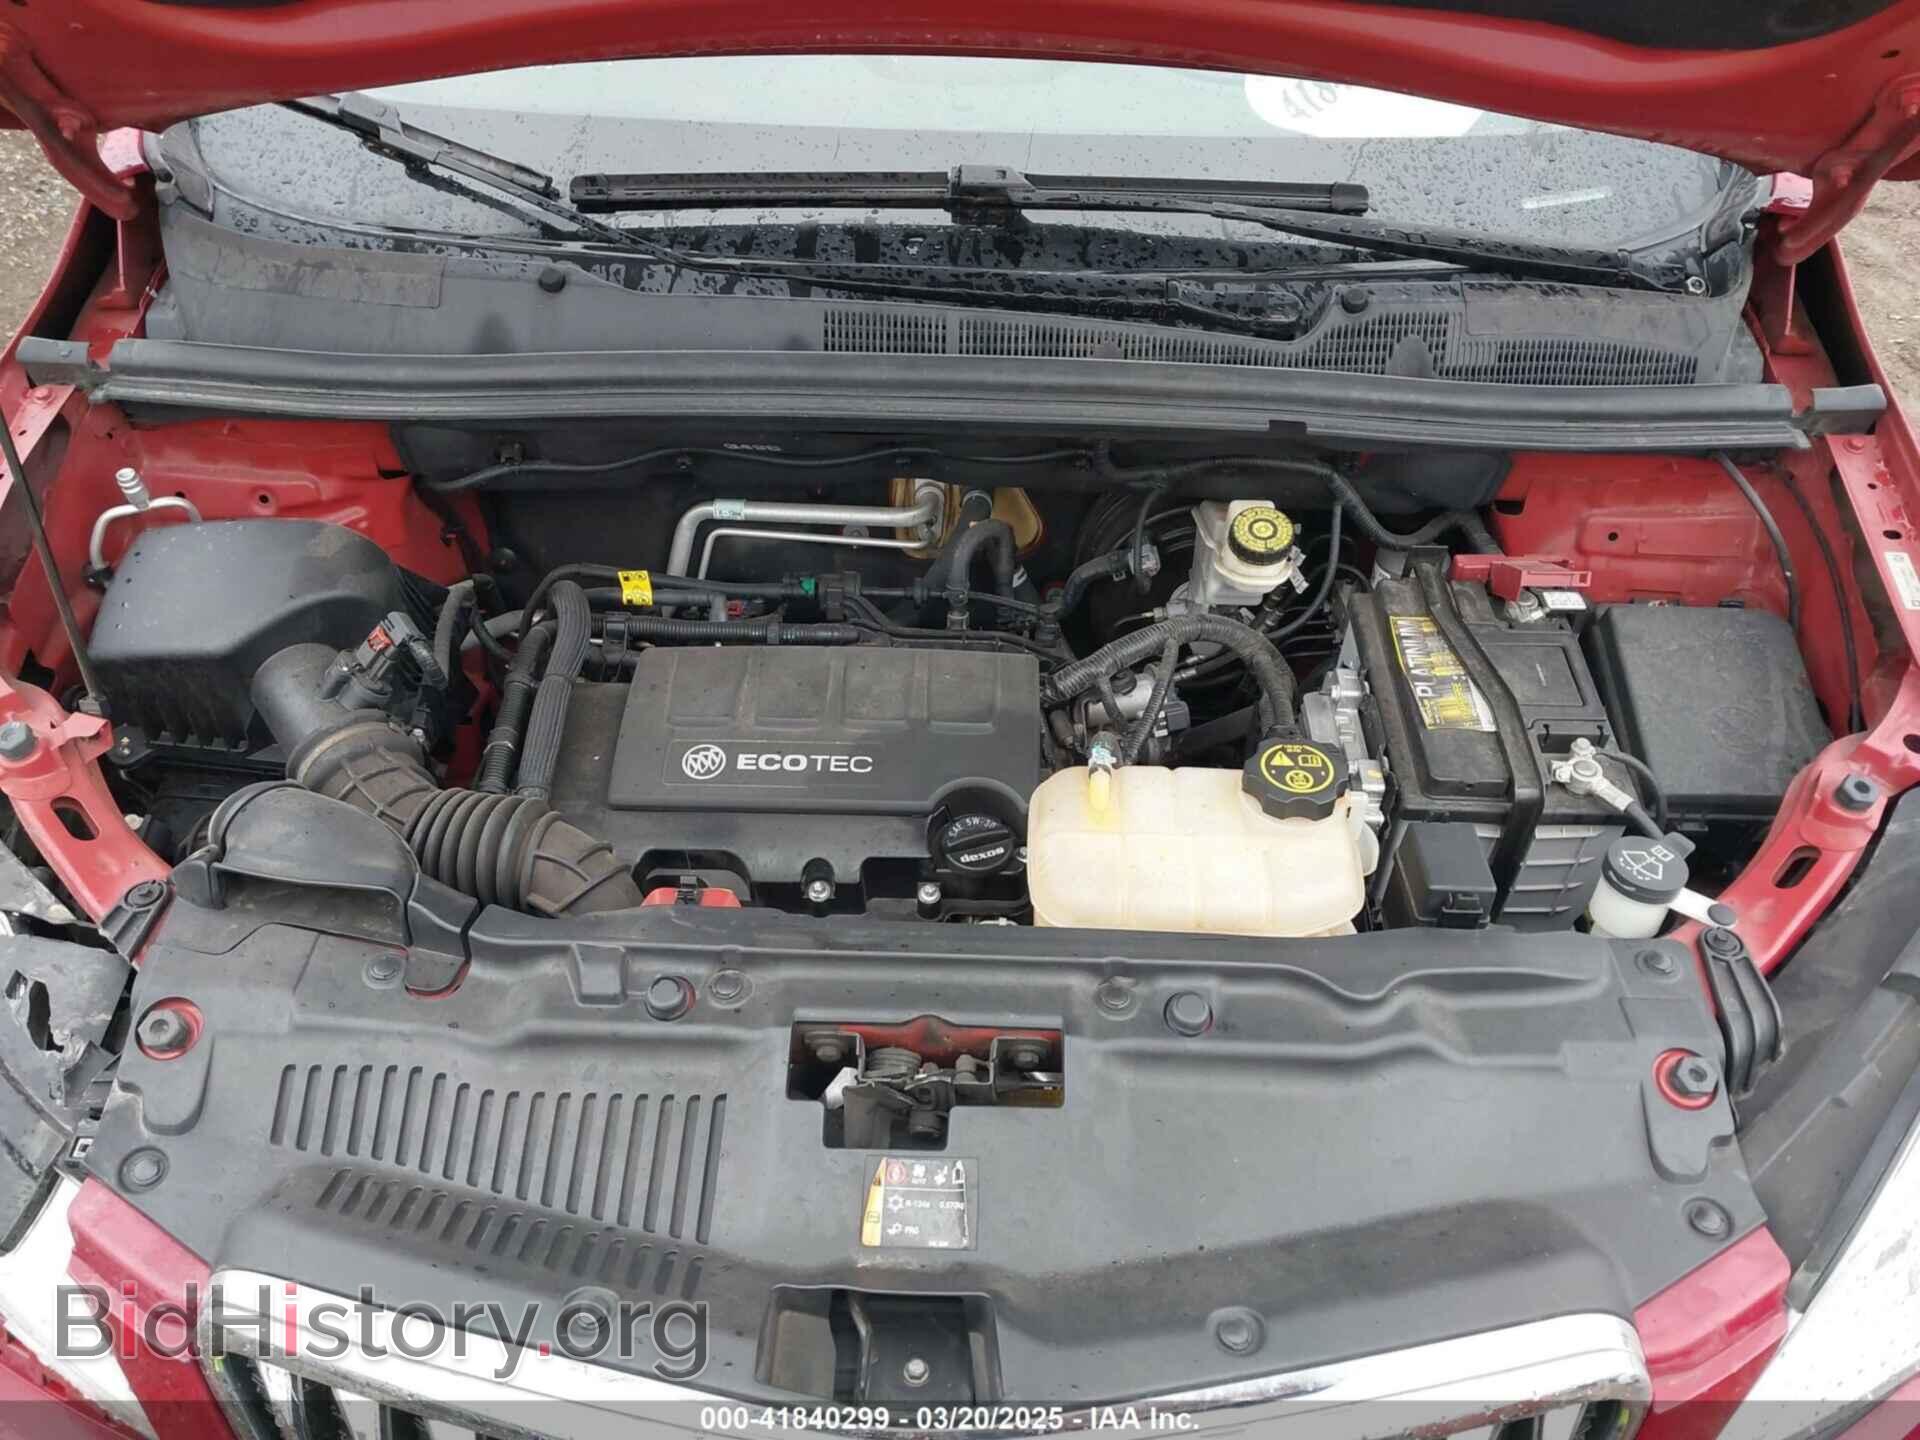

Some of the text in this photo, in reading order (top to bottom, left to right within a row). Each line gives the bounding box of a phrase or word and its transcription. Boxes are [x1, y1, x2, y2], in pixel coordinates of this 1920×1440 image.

[1397, 620, 1434, 697] PLATINUM
[736, 753, 873, 773] ECOTEC
[960, 847, 1004, 863] dexos
